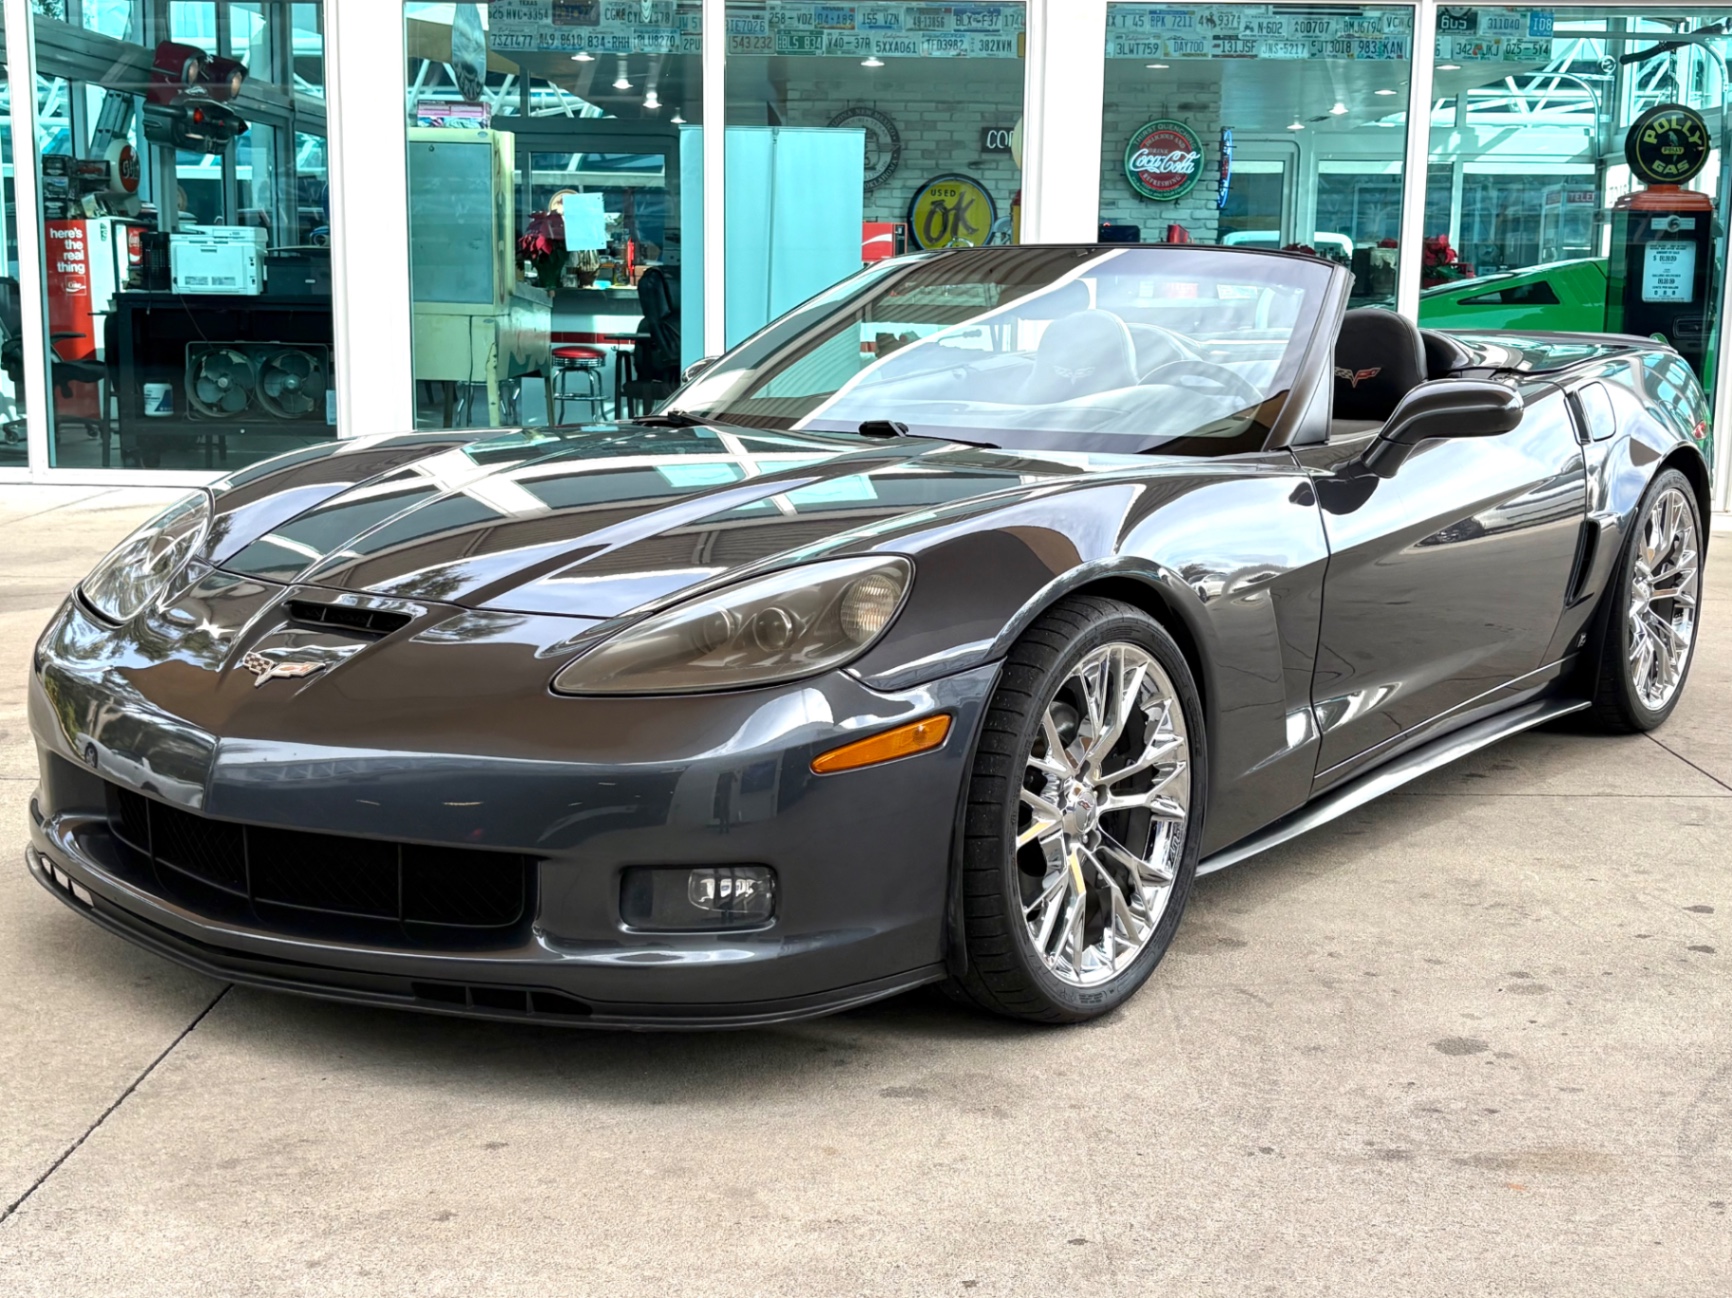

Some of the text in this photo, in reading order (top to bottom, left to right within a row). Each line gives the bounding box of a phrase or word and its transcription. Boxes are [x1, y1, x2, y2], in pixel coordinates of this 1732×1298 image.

[1643, 115, 1703, 146] POLLY
[1652, 160, 1690, 175] GAS
[930, 188, 957, 197] USED
[923, 190, 979, 246] OK
[50, 228, 82, 239] here's
[64, 240, 83, 250] the
[63, 250, 84, 261] real
[57, 262, 85, 275] thing
